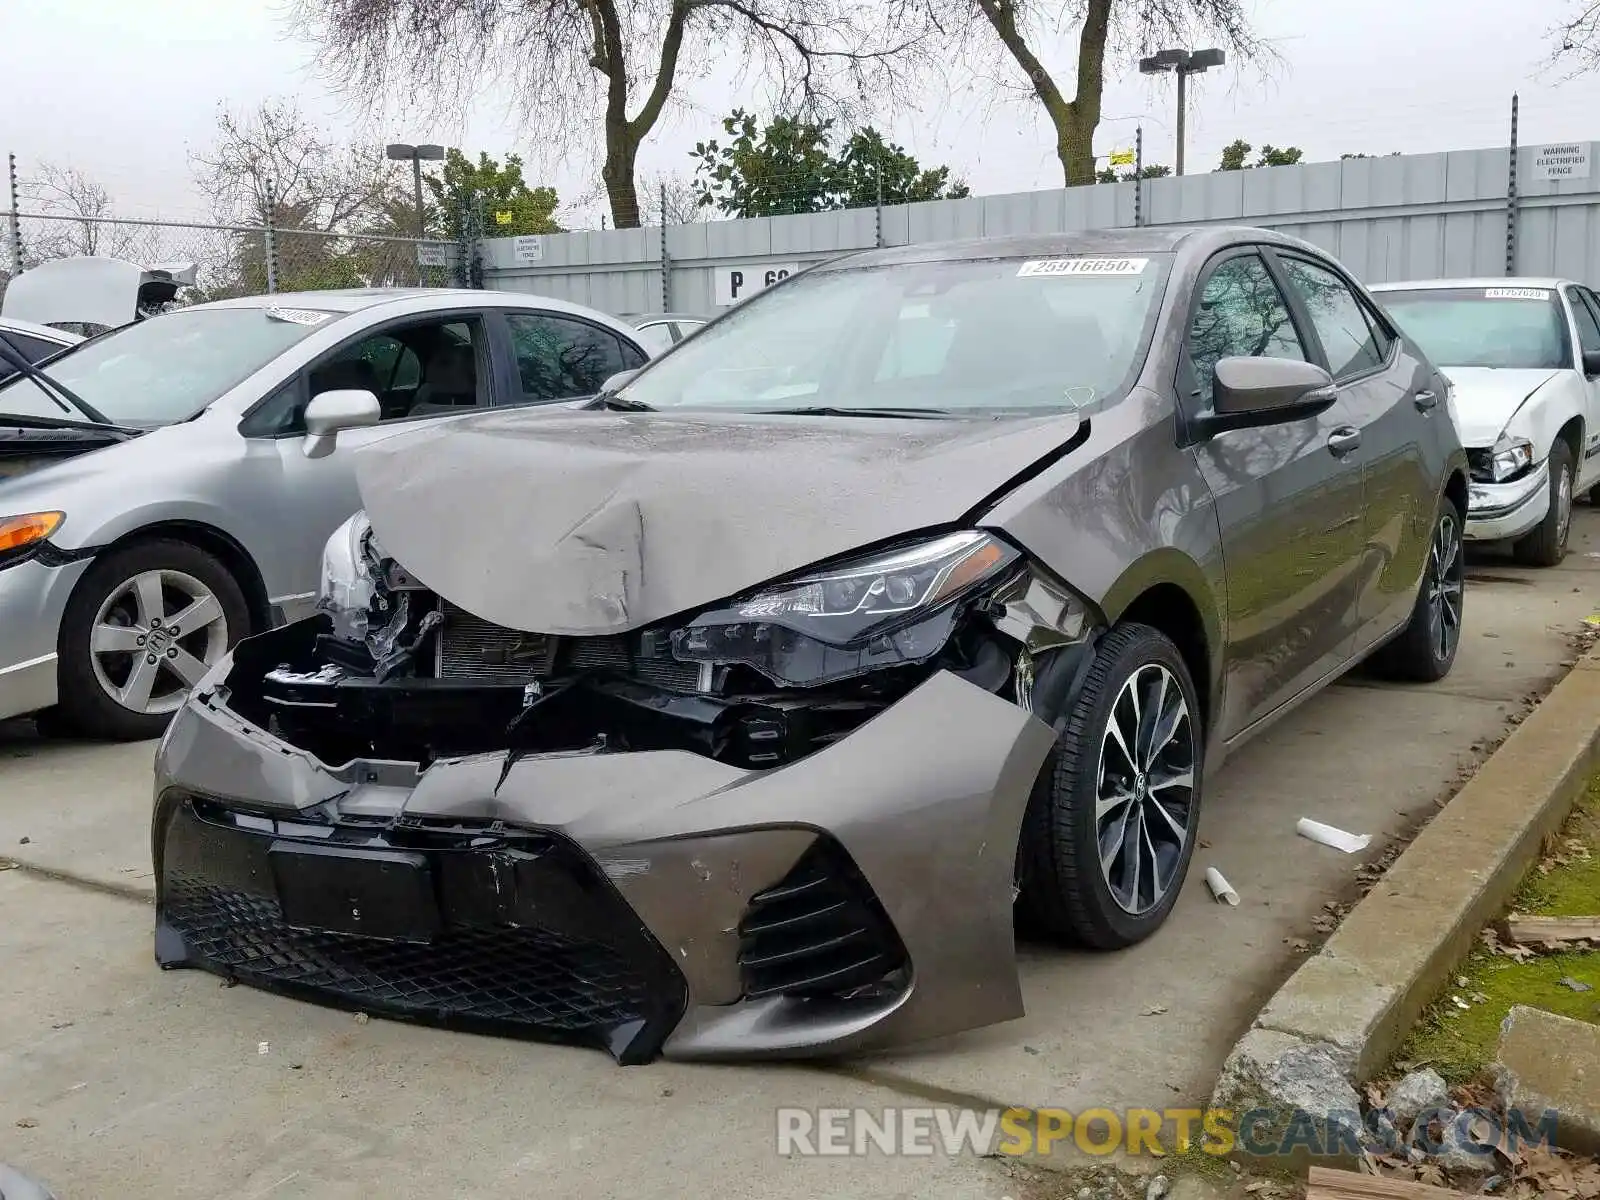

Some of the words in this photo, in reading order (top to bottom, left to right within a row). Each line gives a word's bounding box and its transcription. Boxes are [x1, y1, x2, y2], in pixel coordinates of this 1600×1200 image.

[1543, 146, 1580, 155] WARNING
[1536, 156, 1585, 166] ELECTRIFIED
[1548, 167, 1573, 175] FENCE
[731, 271, 744, 298] P
